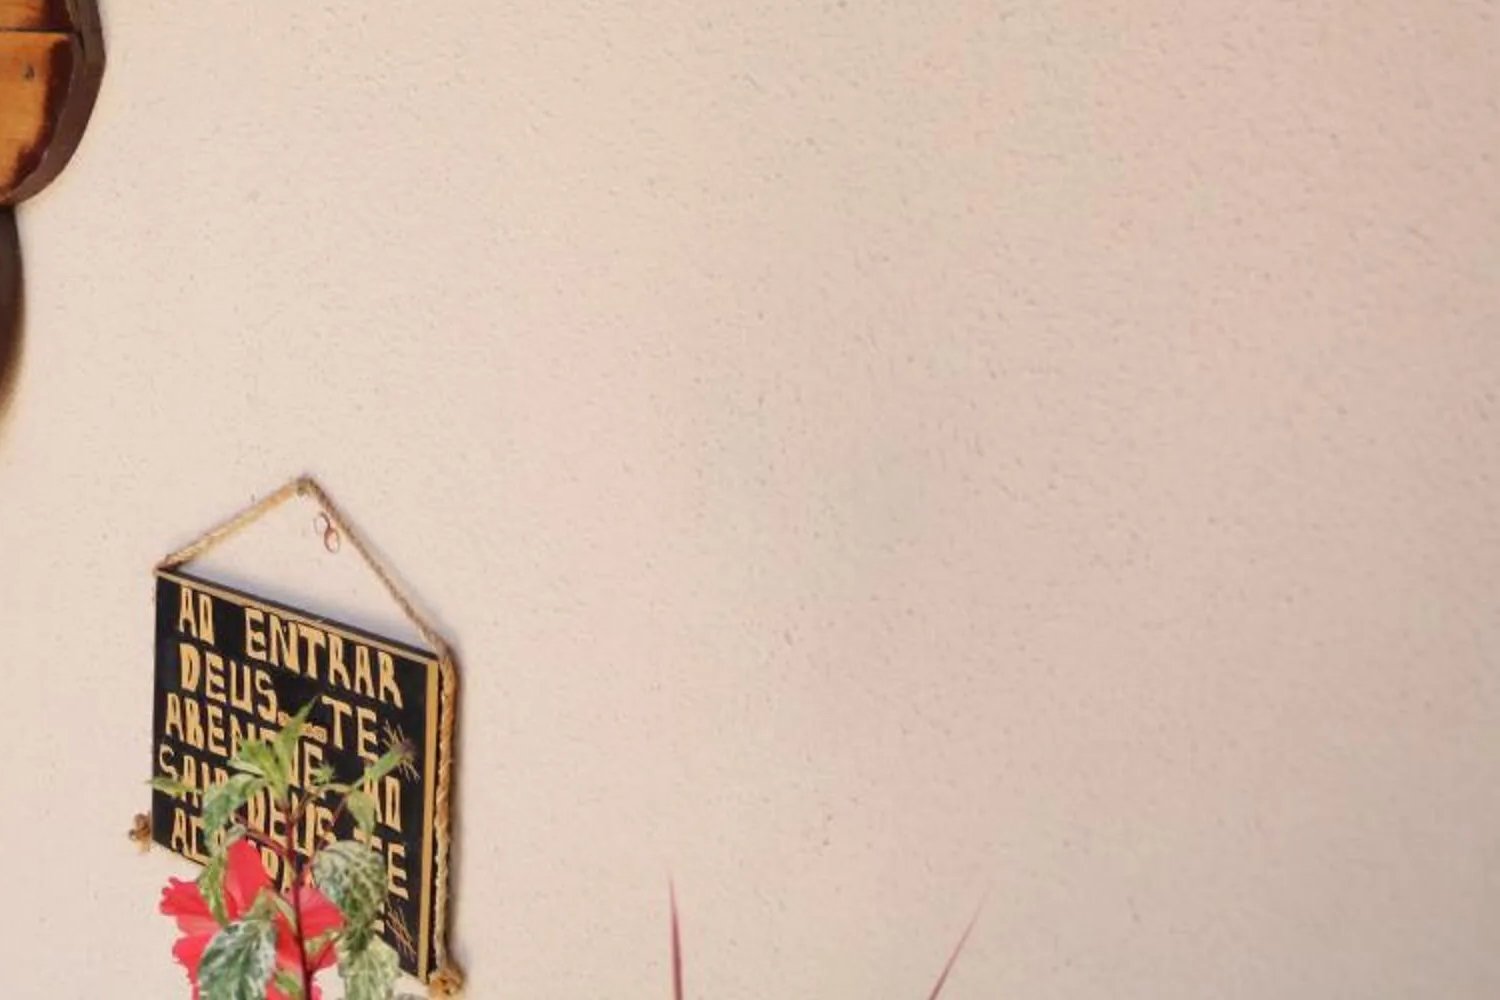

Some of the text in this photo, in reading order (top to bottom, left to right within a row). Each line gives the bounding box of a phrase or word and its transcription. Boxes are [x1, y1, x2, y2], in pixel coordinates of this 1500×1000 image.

[179, 586, 404, 709] AO ENTRAR
[322, 695, 380, 761] TE
